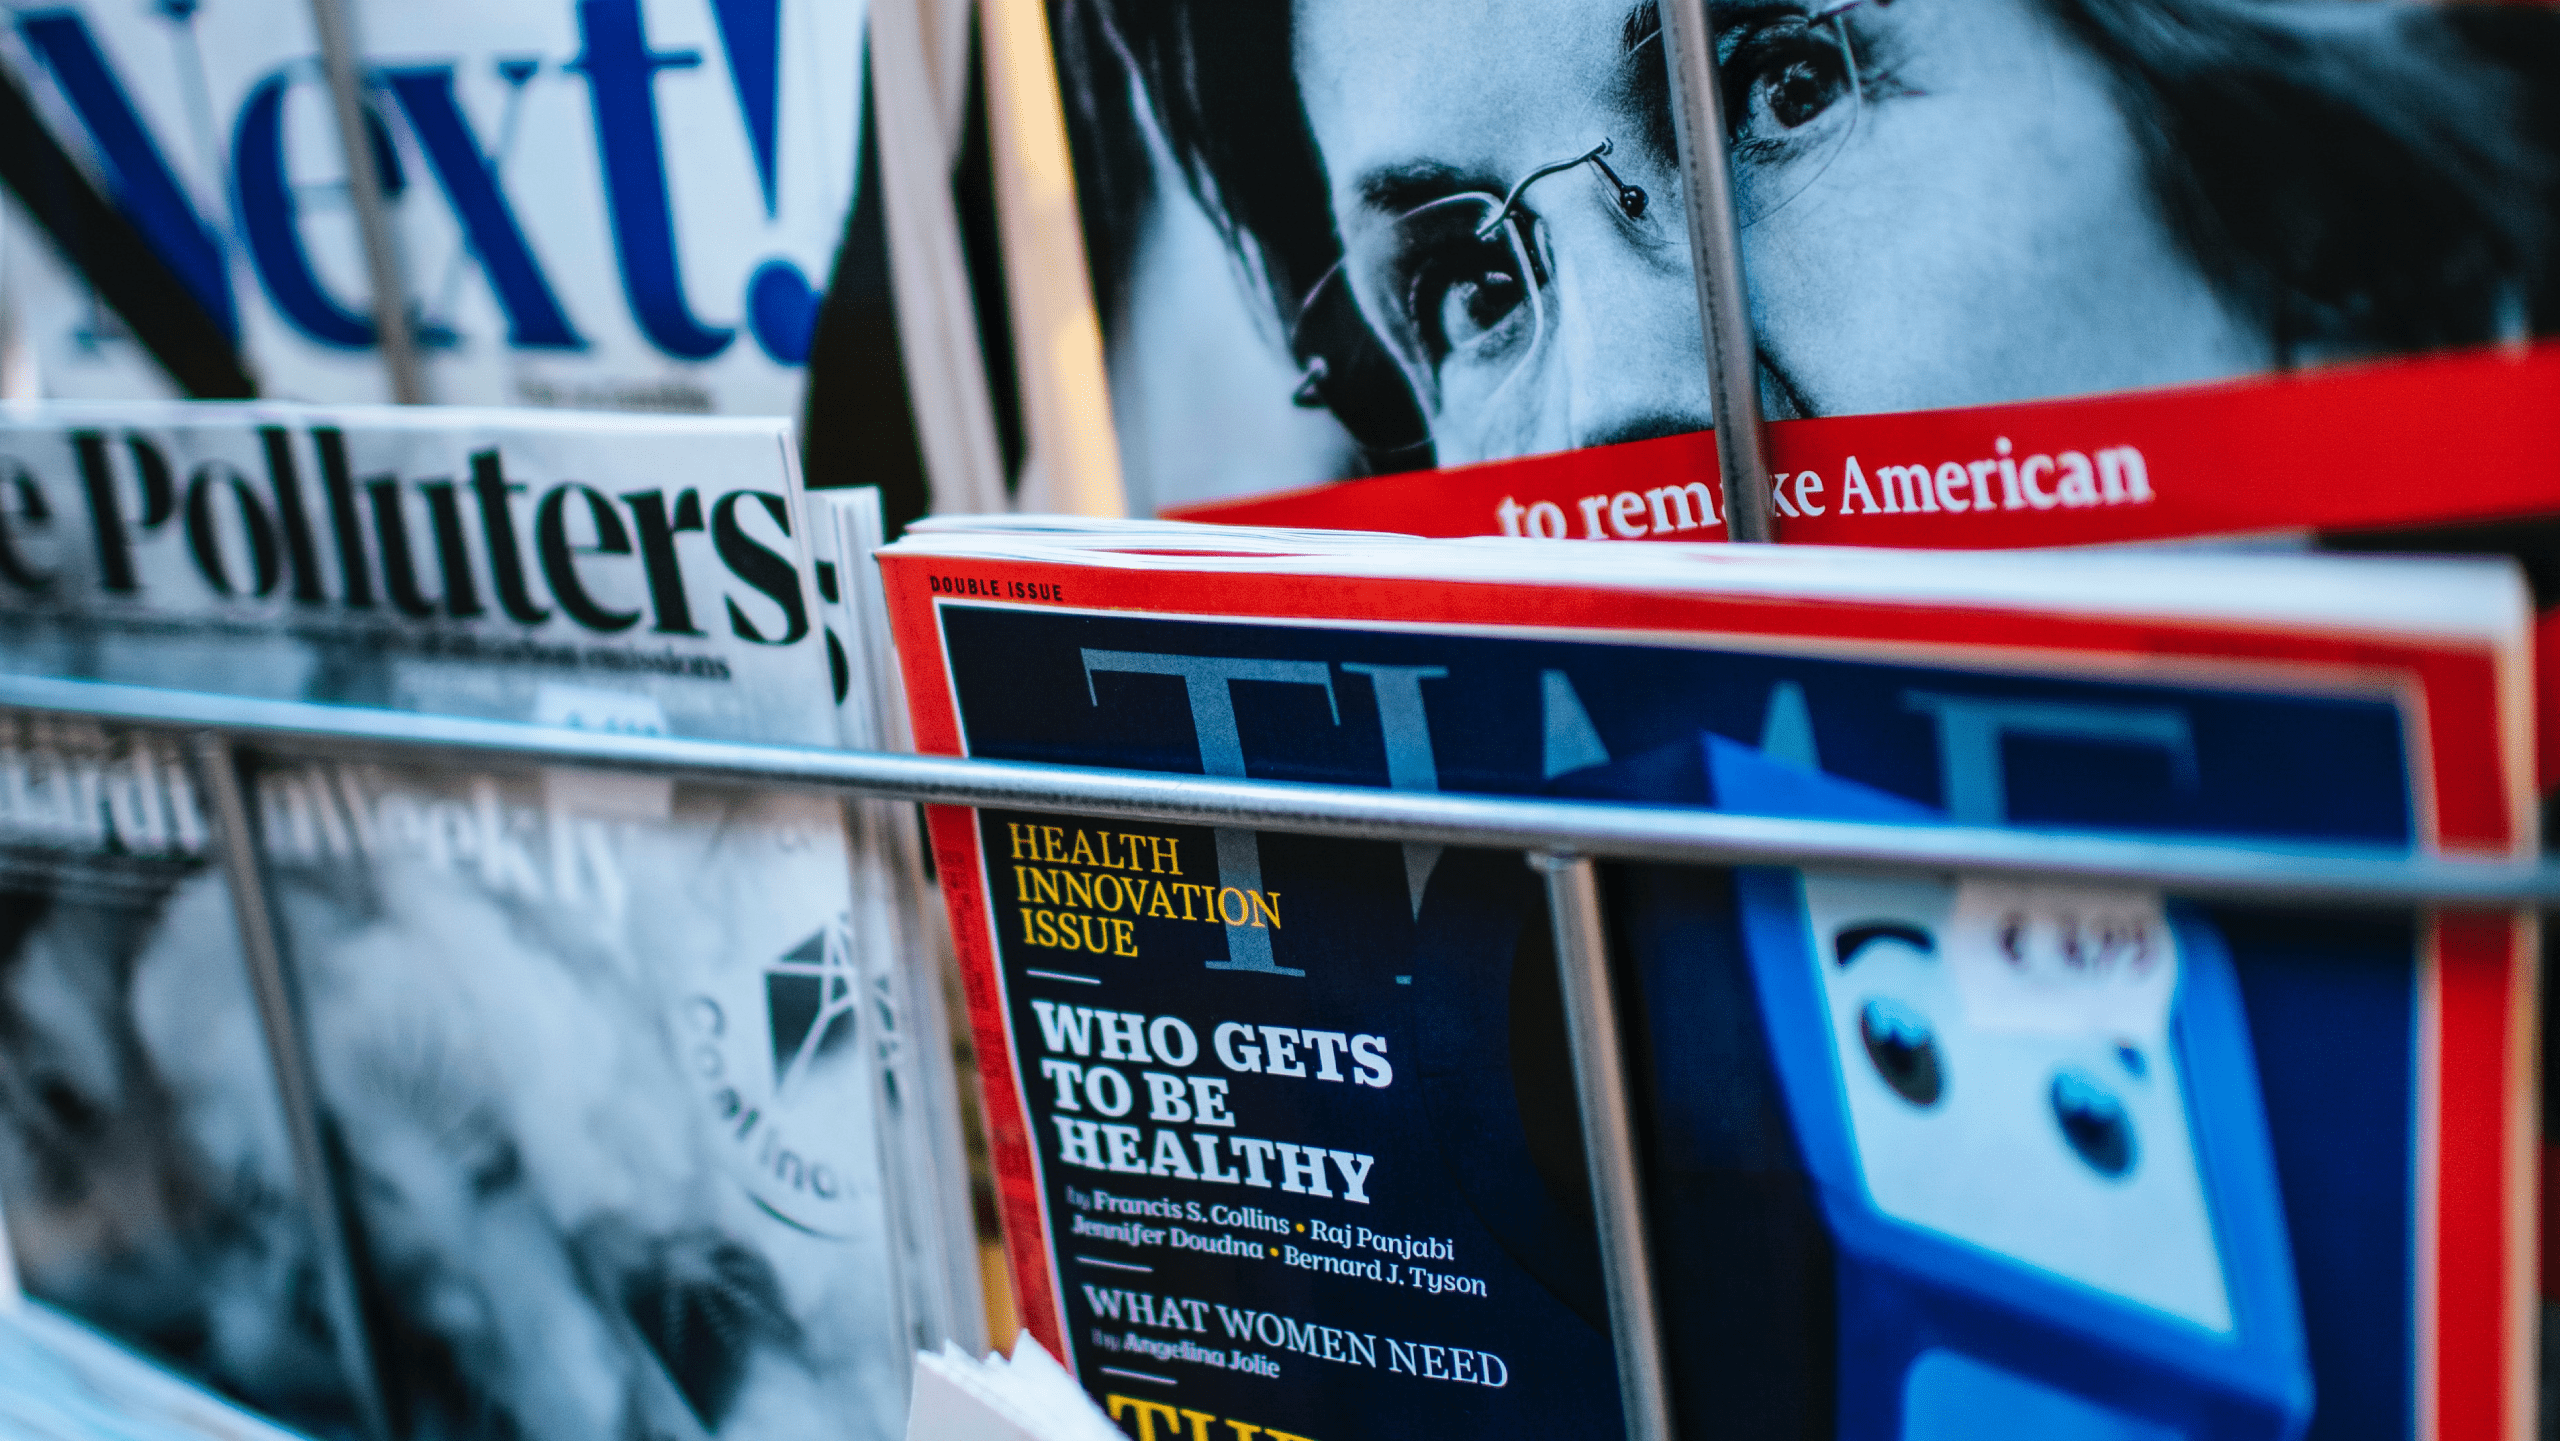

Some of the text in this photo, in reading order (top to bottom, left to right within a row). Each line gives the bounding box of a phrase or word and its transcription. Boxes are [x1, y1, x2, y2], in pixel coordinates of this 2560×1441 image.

[1499, 434, 2152, 540] to remke American
[70, 426, 812, 647] Polluters
[929, 575, 1064, 602] DOUBLE ISSUE
[1007, 821, 1184, 876] HEALTH
[1012, 865, 1282, 930] INNOVATION
[1020, 907, 1139, 959] ISSUE
[1030, 998, 1395, 1091] WHO GETS
[1040, 1058, 1237, 1129] TO BE
[1051, 1114, 1376, 1206] HEALTHY
[1070, 1213, 1490, 1299] Jennifer Doudna Bernard J. Tyson
[1092, 1189, 1184, 1221] Francis
[1186, 1201, 1209, 1225] S.
[1211, 1205, 1291, 1236] Collins
[1310, 1218, 1353, 1250] Raj
[1356, 1226, 1456, 1263] Panjabi
[1081, 1283, 1510, 1389] WHAT WOMEN NEED
[1122, 1332, 1226, 1369] Angelina
[1227, 1348, 1282, 1380] Jolie
